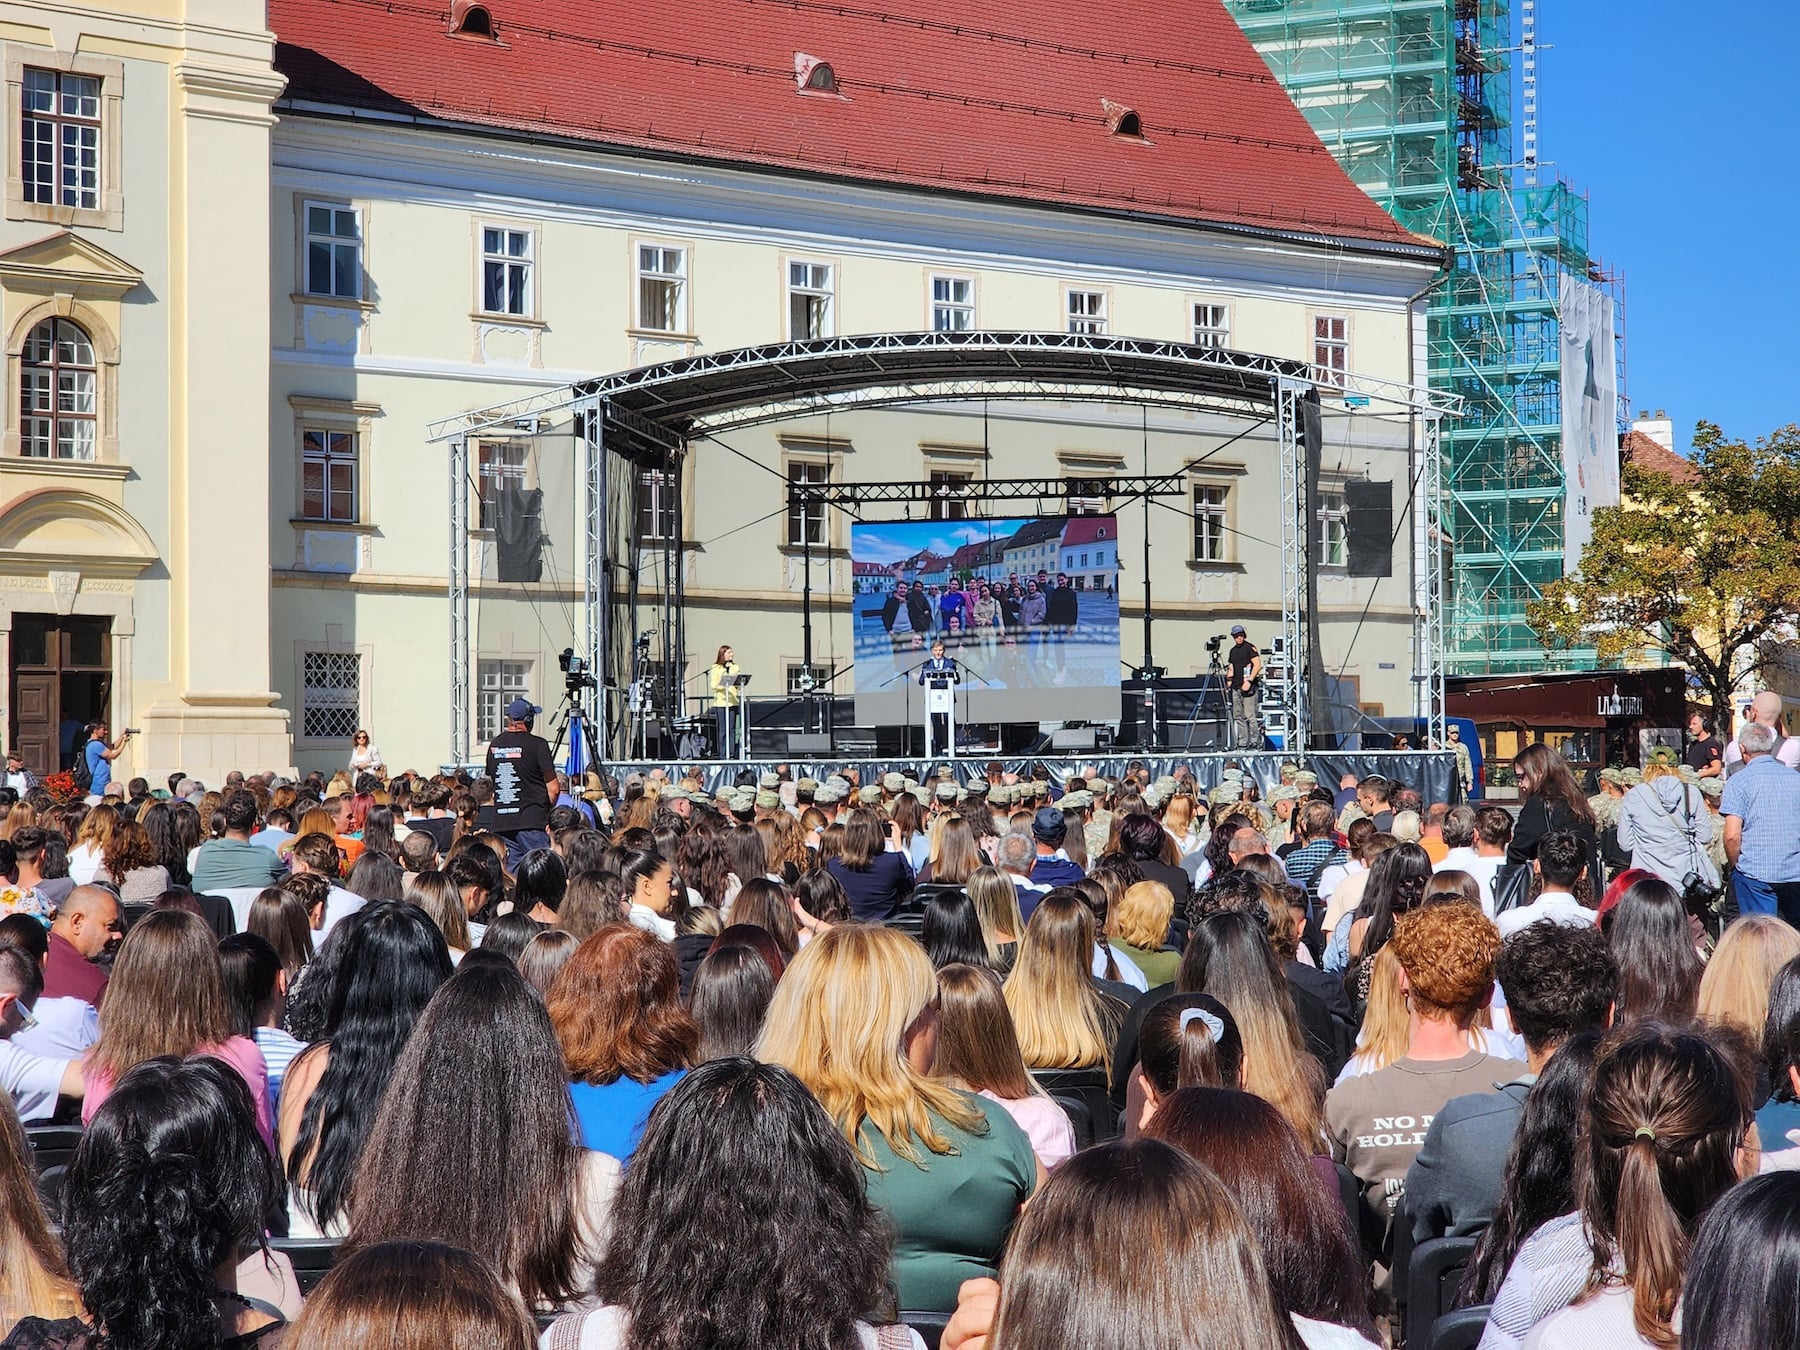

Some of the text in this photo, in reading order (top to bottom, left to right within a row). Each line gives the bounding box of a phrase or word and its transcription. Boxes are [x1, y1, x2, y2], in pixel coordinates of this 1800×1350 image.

[1597, 695, 1643, 715] LA TURN
[1373, 1116, 1416, 1131] NO
